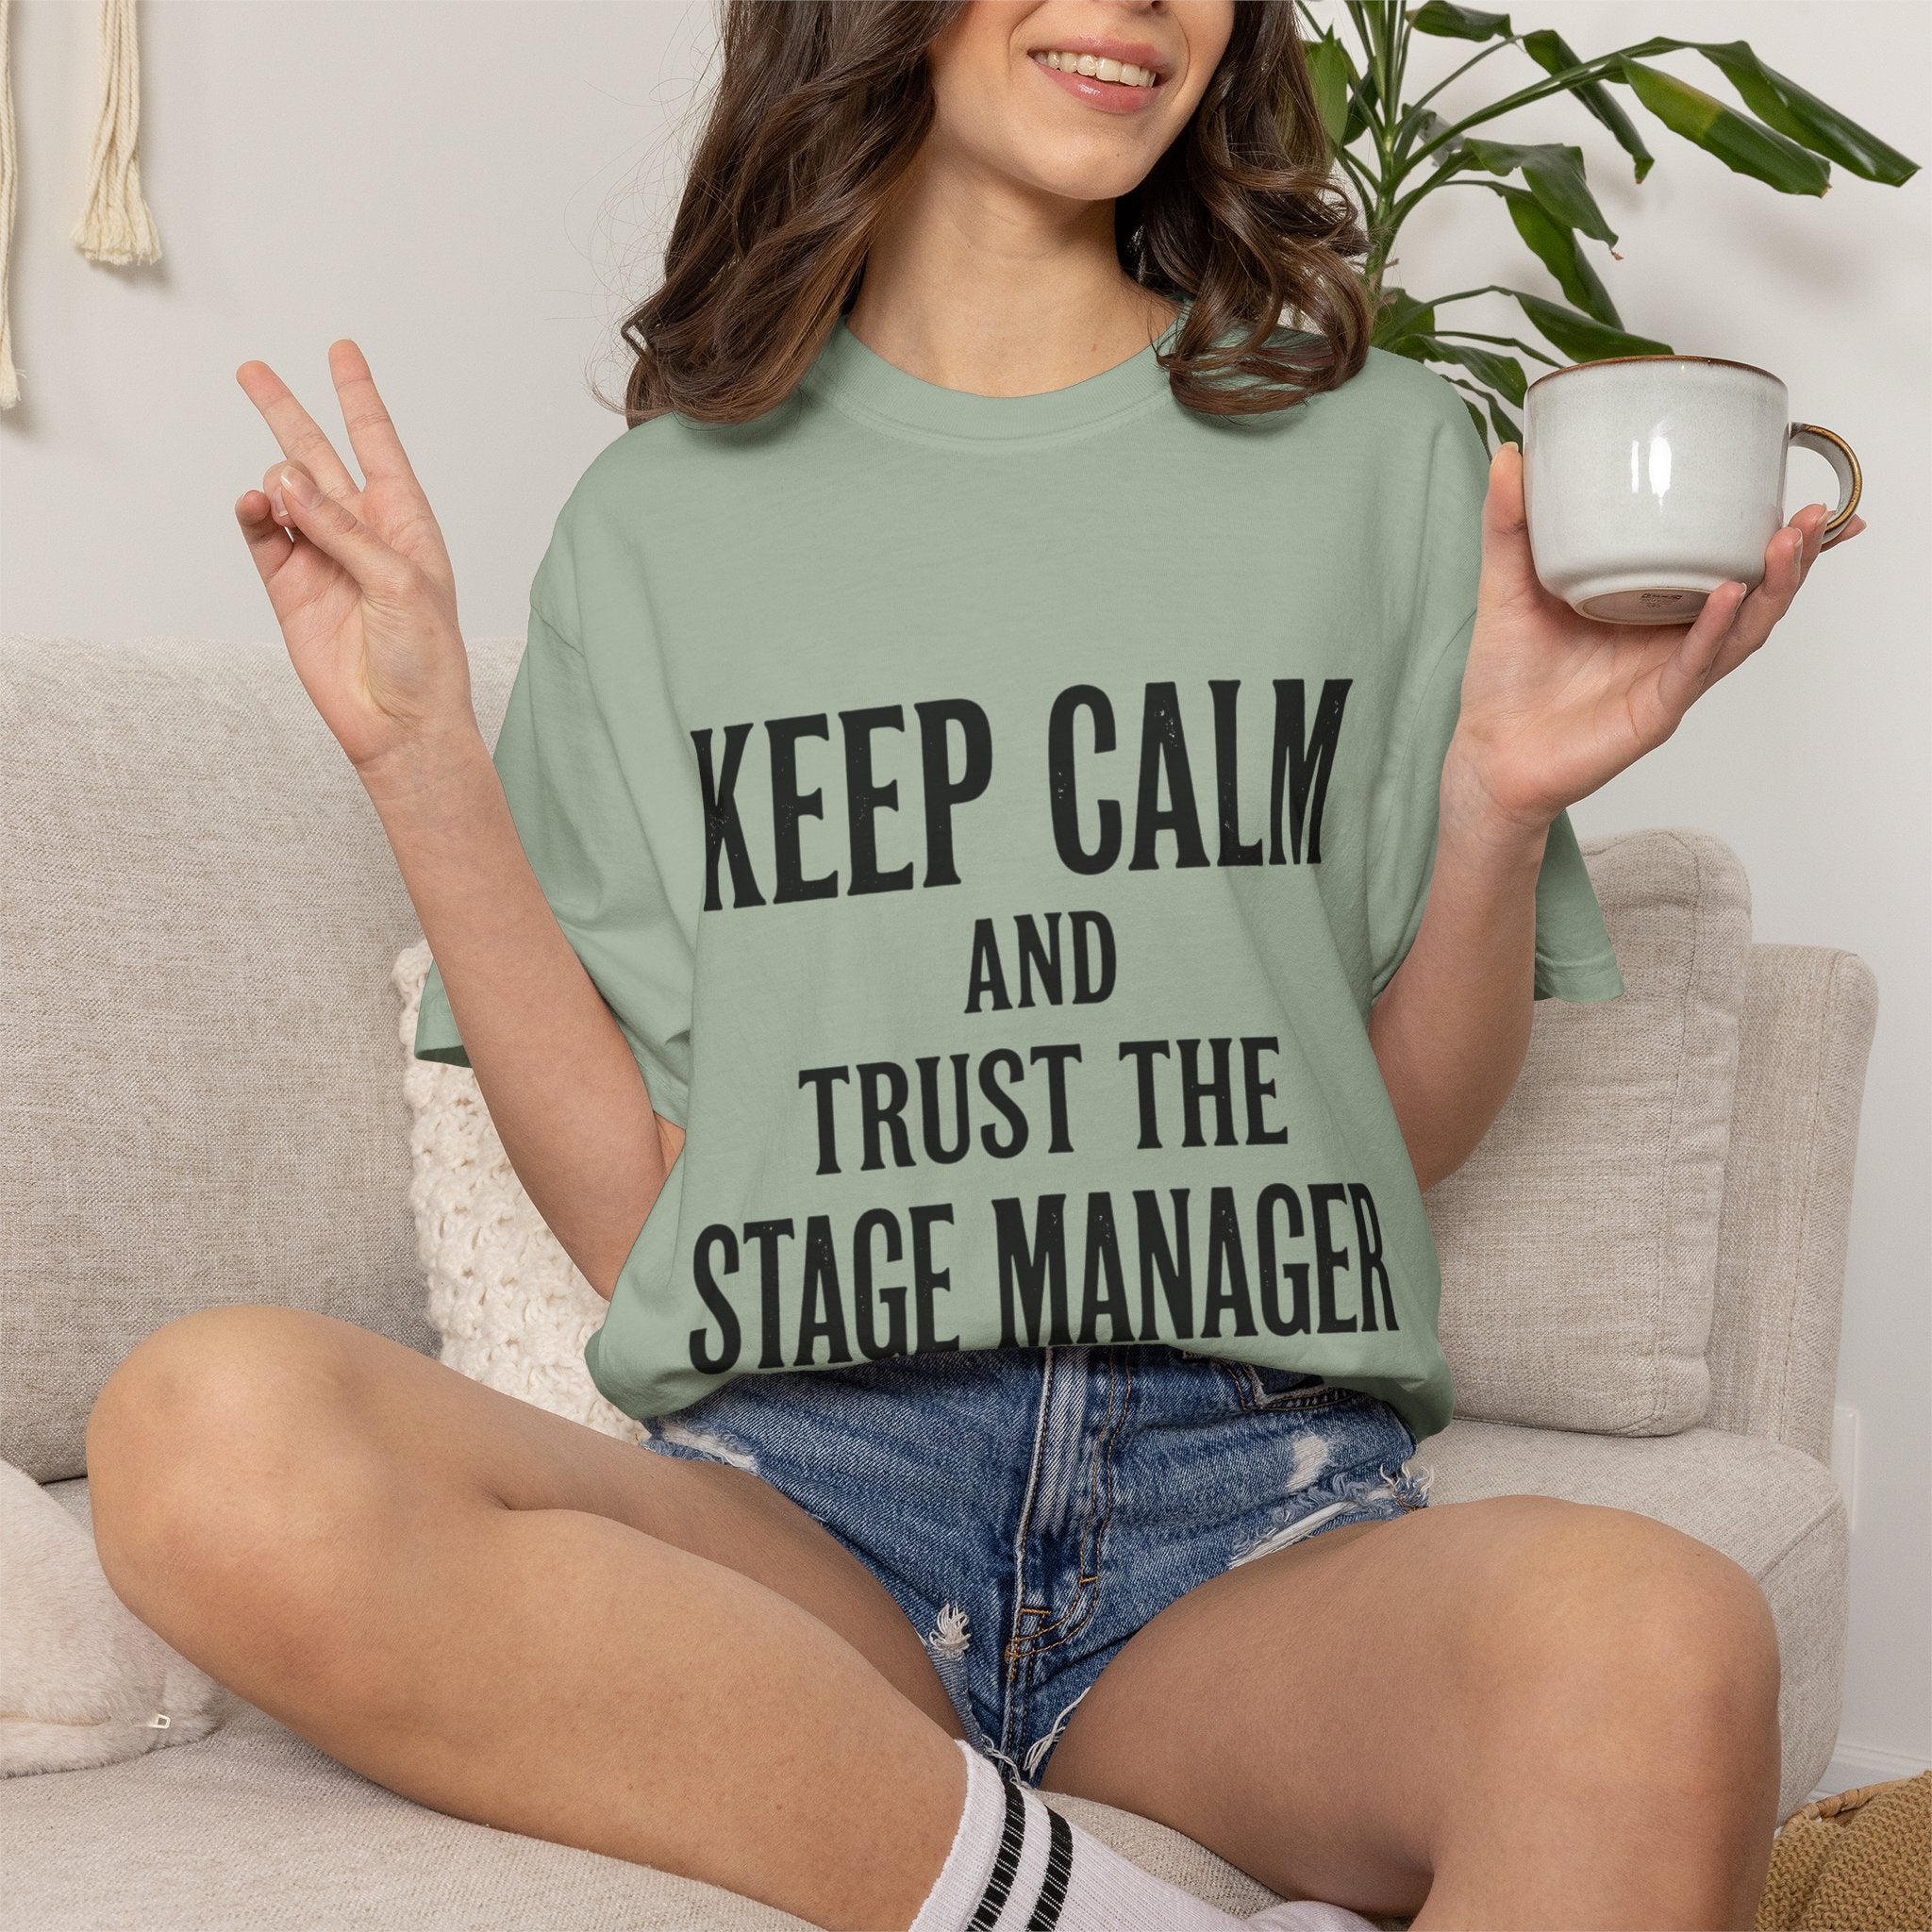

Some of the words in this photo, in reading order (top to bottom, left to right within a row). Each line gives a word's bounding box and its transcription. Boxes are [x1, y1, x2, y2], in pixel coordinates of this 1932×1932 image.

[691, 699, 991, 912] KEEP
[1049, 679, 1354, 874] CALM
[964, 911, 1117, 1013] AND
[798, 1043, 1082, 1175] TRUST
[1119, 1036, 1289, 1149] THE
[689, 1203, 960, 1376] STAGE
[991, 1183, 1400, 1348] MANAGER
